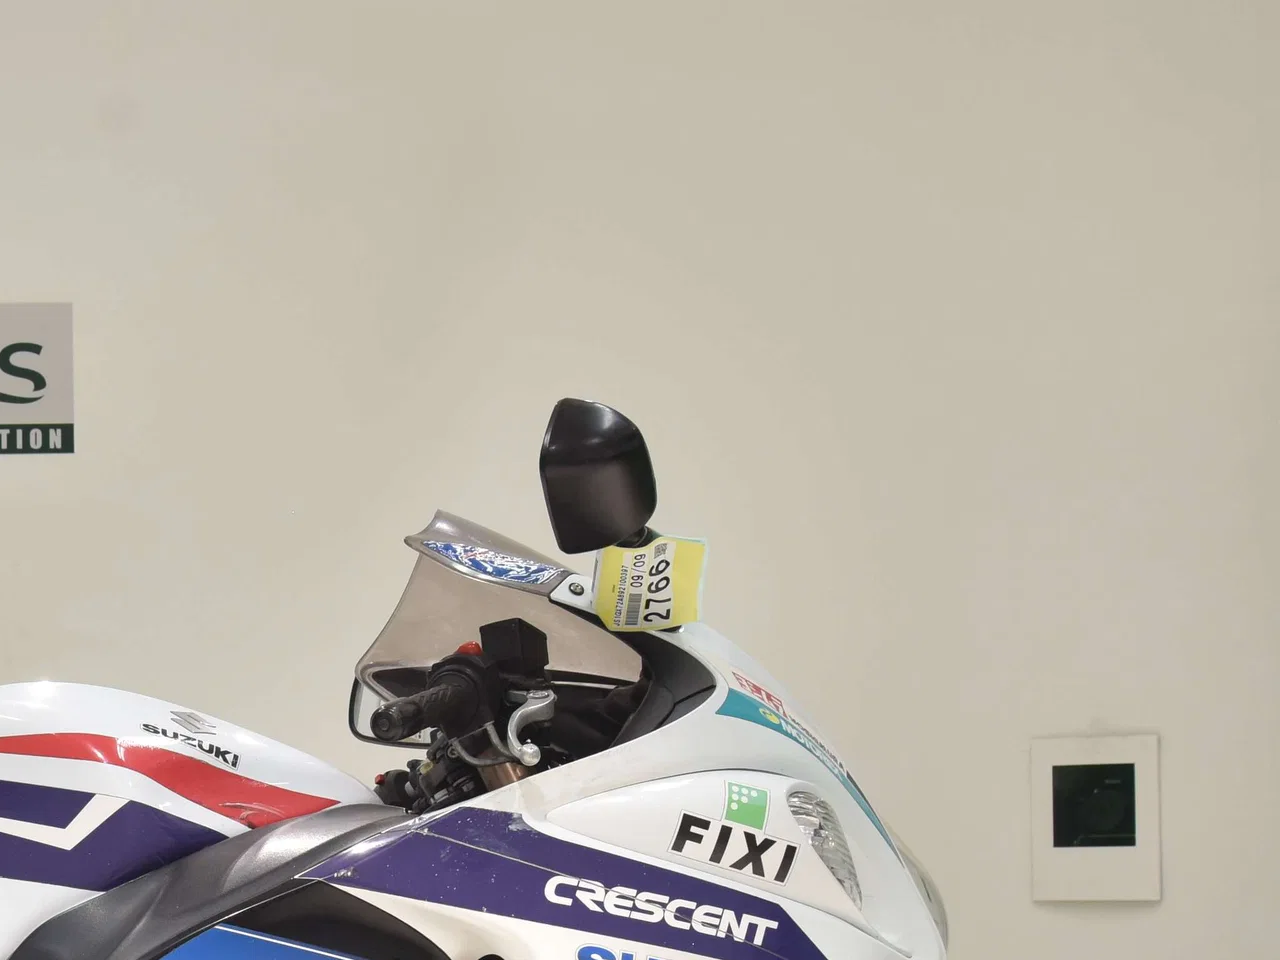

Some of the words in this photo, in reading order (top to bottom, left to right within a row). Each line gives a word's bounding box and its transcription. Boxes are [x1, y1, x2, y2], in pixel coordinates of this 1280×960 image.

[630, 553, 647, 588] 09/09
[643, 559, 671, 623] 2766
[142, 723, 240, 769] SUZUKI
[671, 812, 797, 884] FIXI
[544, 875, 779, 946] CRESCENT
